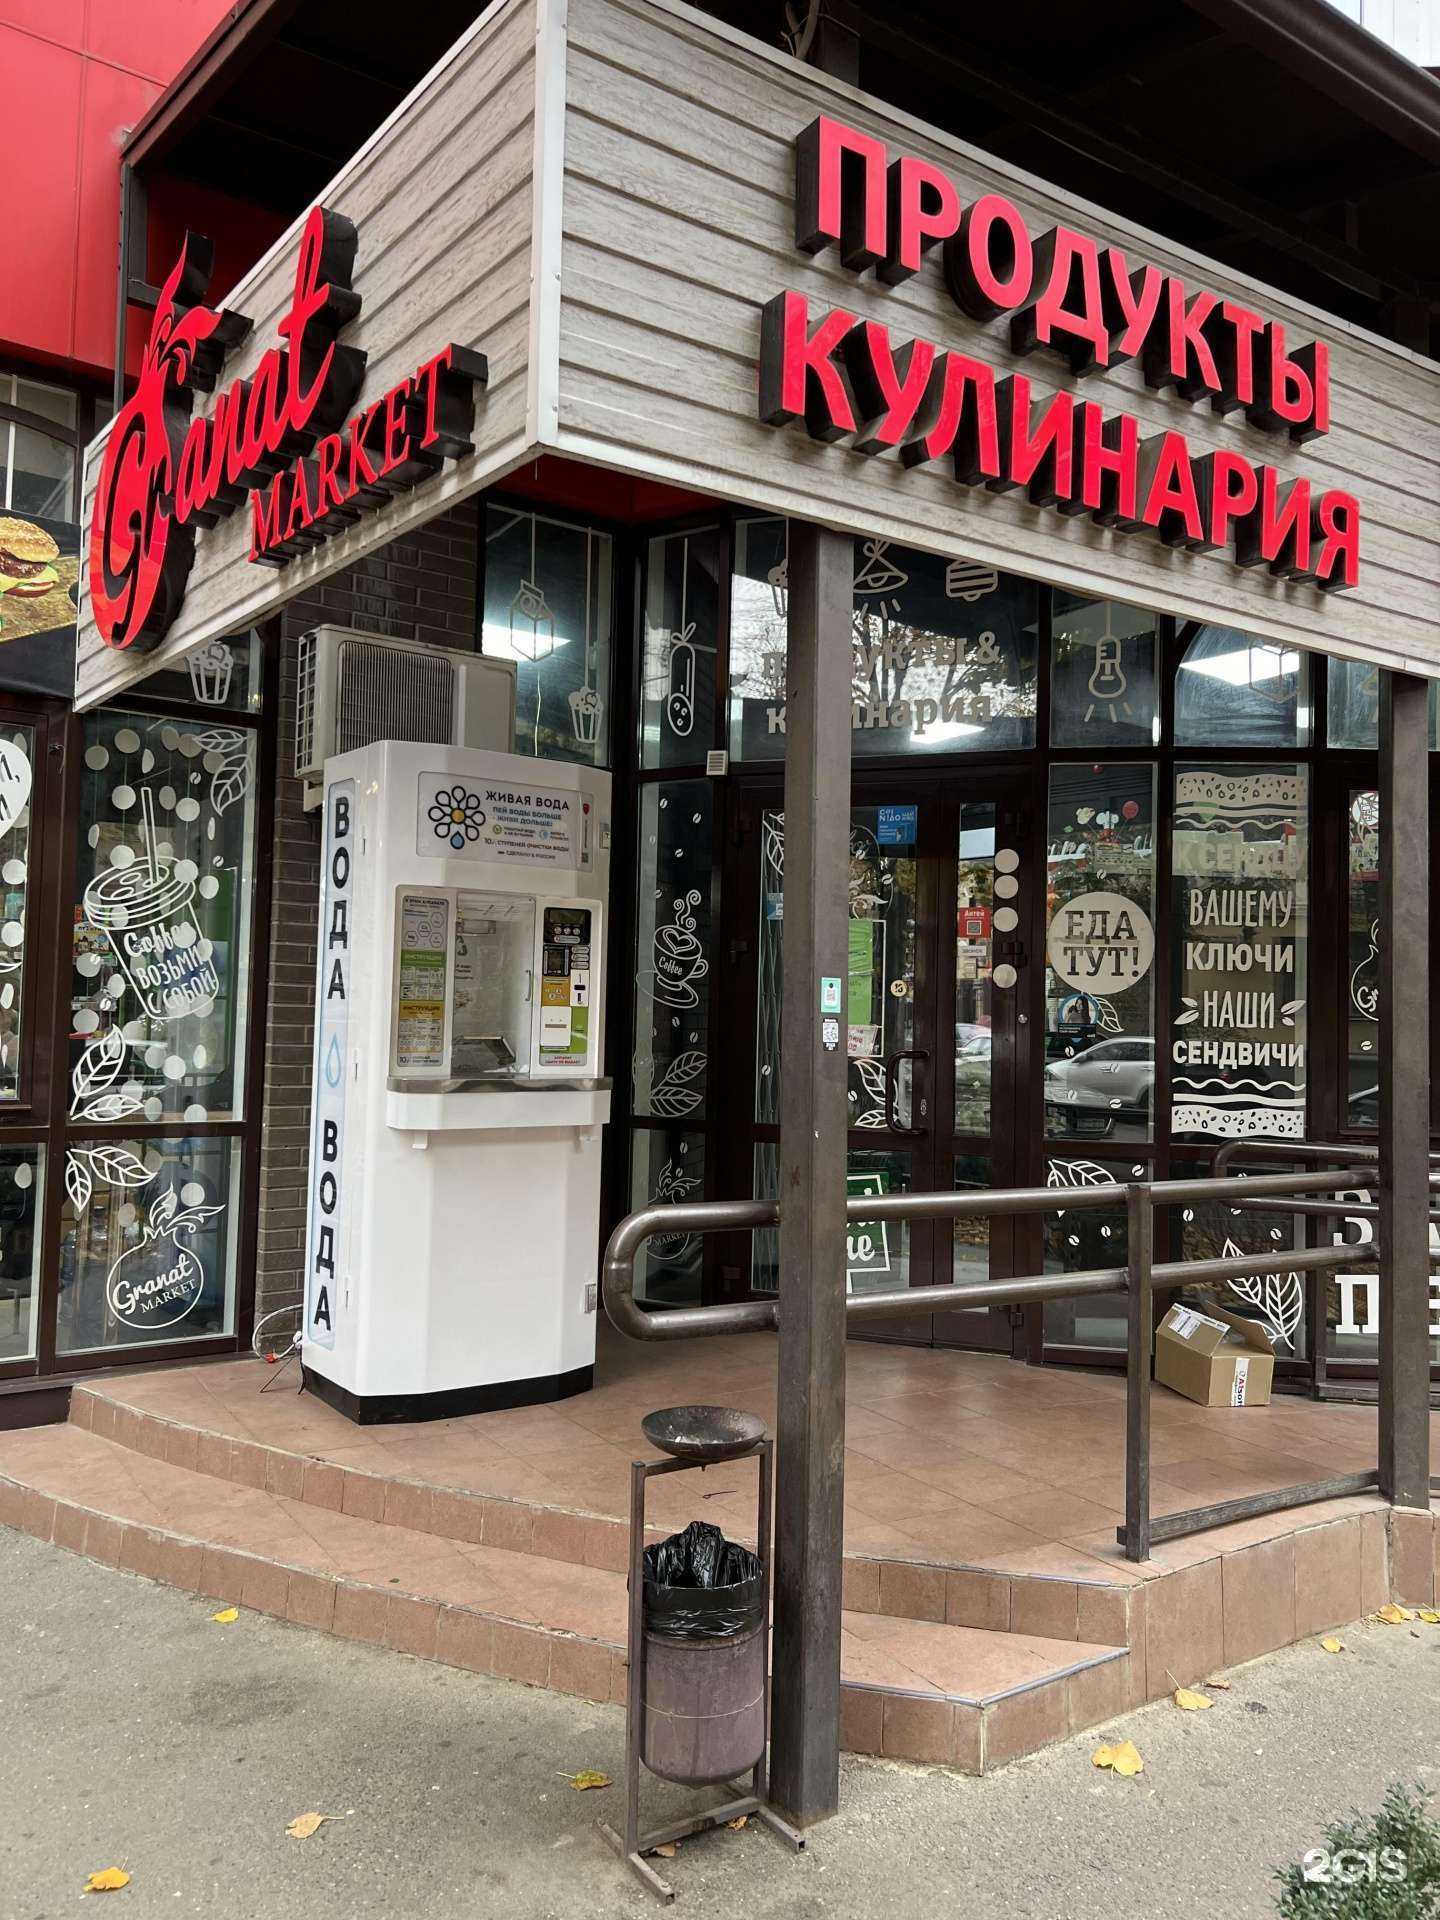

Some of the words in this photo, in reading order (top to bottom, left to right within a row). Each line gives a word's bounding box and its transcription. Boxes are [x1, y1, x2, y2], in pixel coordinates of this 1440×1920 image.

[815, 114, 1330, 436] ПРОДУКТЫ
[248, 343, 452, 564] MARKET
[779, 289, 1359, 587] КУЛИНАРИЯ
[485, 790, 531, 806] ЖИВАЯ
[536, 797, 570, 811] ВОДА
[327, 797, 350, 1001] ВОДА
[1189, 889, 1293, 928] ВАШЕМУ
[1064, 910, 1138, 944] ЕДА
[136, 945, 204, 989] ВОЗЬМИ
[658, 956, 683, 976] Coffee
[1063, 946, 1139, 978] ТУТ!
[1186, 942, 1294, 973] КЛЮЧИ
[147, 991, 161, 1014] С
[163, 967, 217, 1009] СОБОЙ
[1203, 990, 1275, 1029] НАШИ
[1172, 1040, 1304, 1070] СЕНДВИЧИ
[313, 1119, 338, 1333] ВОДА
[112, 1253, 193, 1315] Granat
[140, 1279, 196, 1313] MARKET
